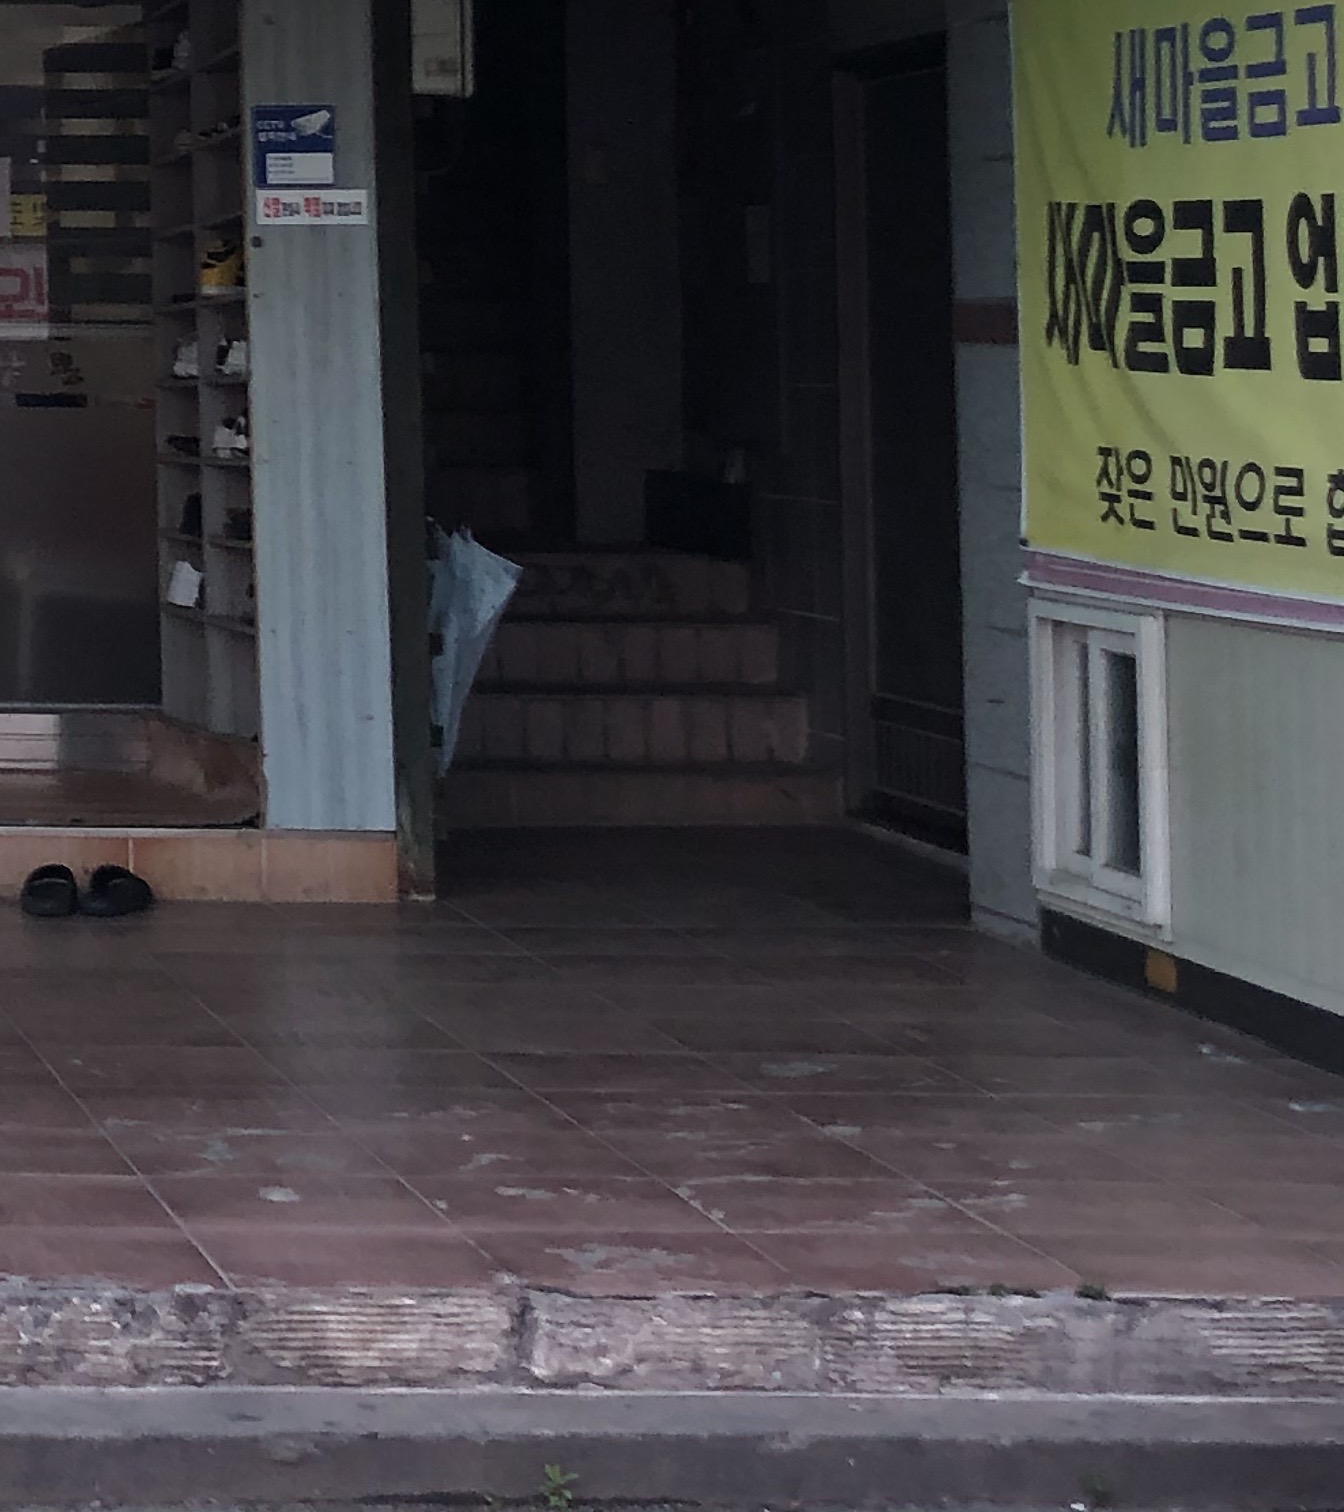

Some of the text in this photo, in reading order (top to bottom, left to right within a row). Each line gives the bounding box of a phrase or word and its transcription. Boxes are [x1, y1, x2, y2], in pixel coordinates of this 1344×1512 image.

[1107, 3, 1342, 148] 새마을금고
[1095, 445, 1157, 531] 잦은
[1169, 454, 1308, 548] 민원으로
